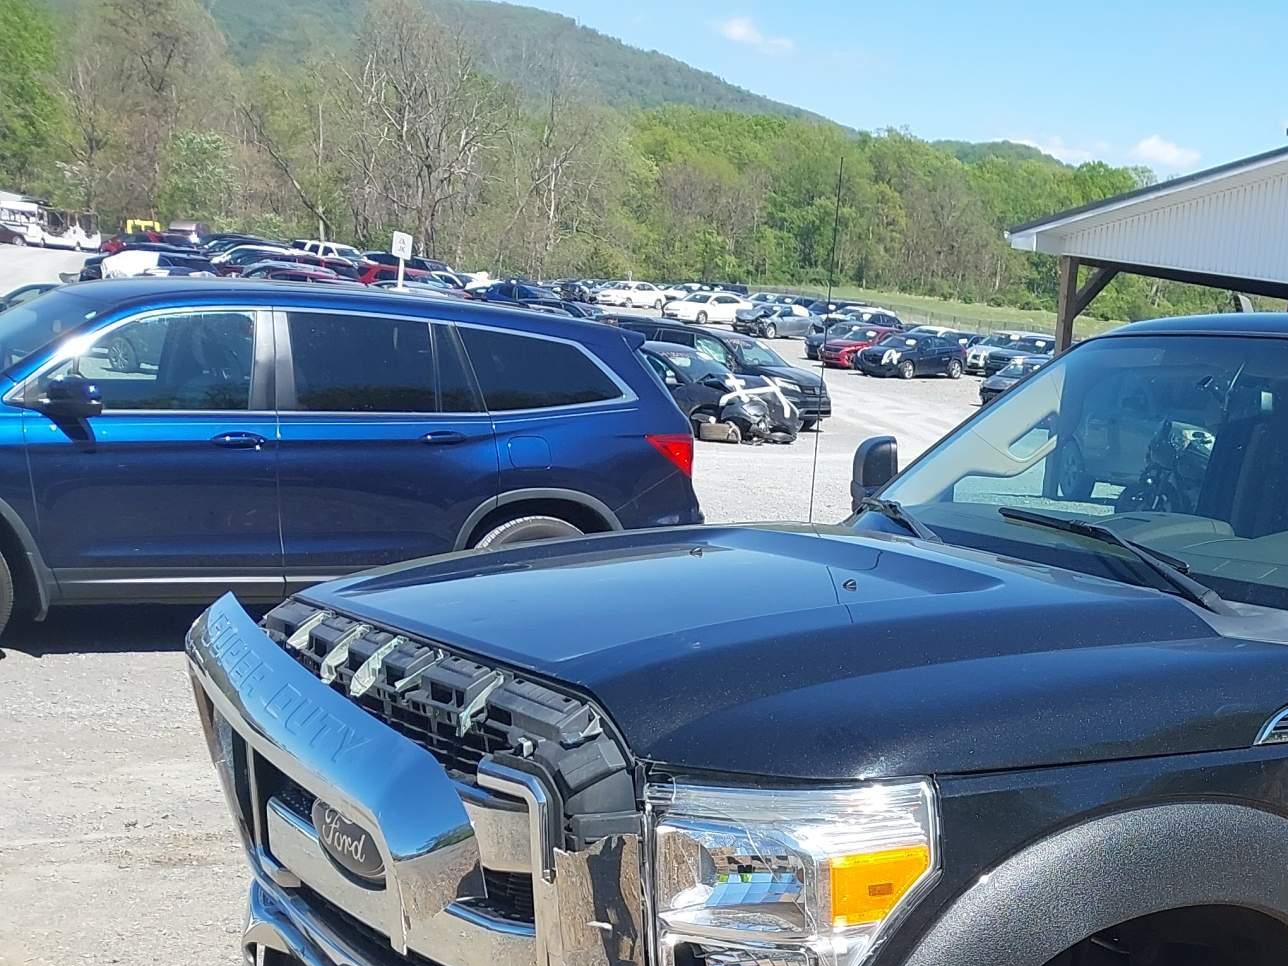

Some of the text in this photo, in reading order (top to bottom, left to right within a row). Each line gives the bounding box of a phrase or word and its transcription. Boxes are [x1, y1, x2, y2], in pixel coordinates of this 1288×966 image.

[204, 612, 374, 763] SUPER DUTY
[322, 807, 366, 863] Ford
